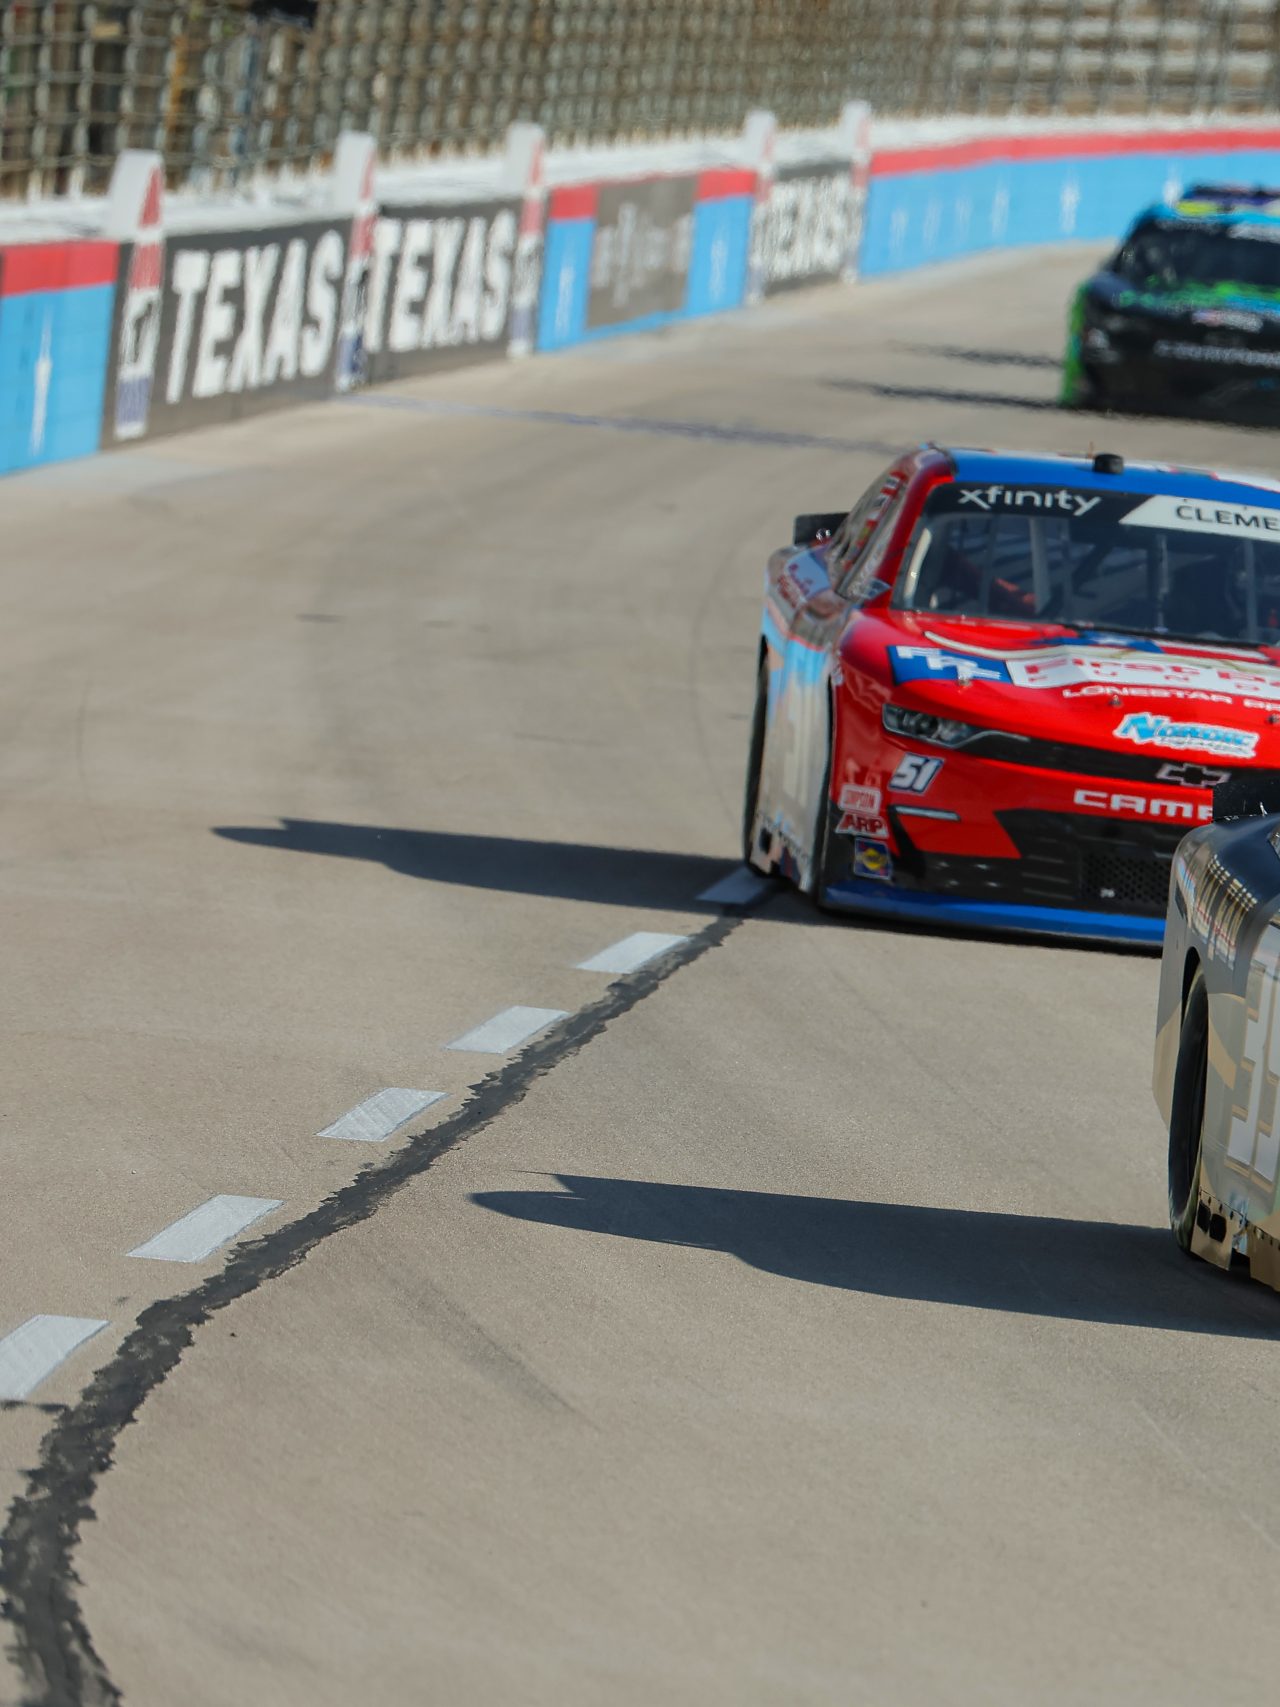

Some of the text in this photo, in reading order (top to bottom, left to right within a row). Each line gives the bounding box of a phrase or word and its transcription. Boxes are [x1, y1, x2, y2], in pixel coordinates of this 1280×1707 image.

[363, 209, 516, 352] TEXAS
[166, 229, 344, 404] TEXAS
[958, 485, 1102, 516] xfinity
[1062, 685, 1232, 704] LONESTAR
[890, 753, 943, 794] 51
[1074, 788, 1213, 822] CAM
[841, 812, 883, 833] ARP
